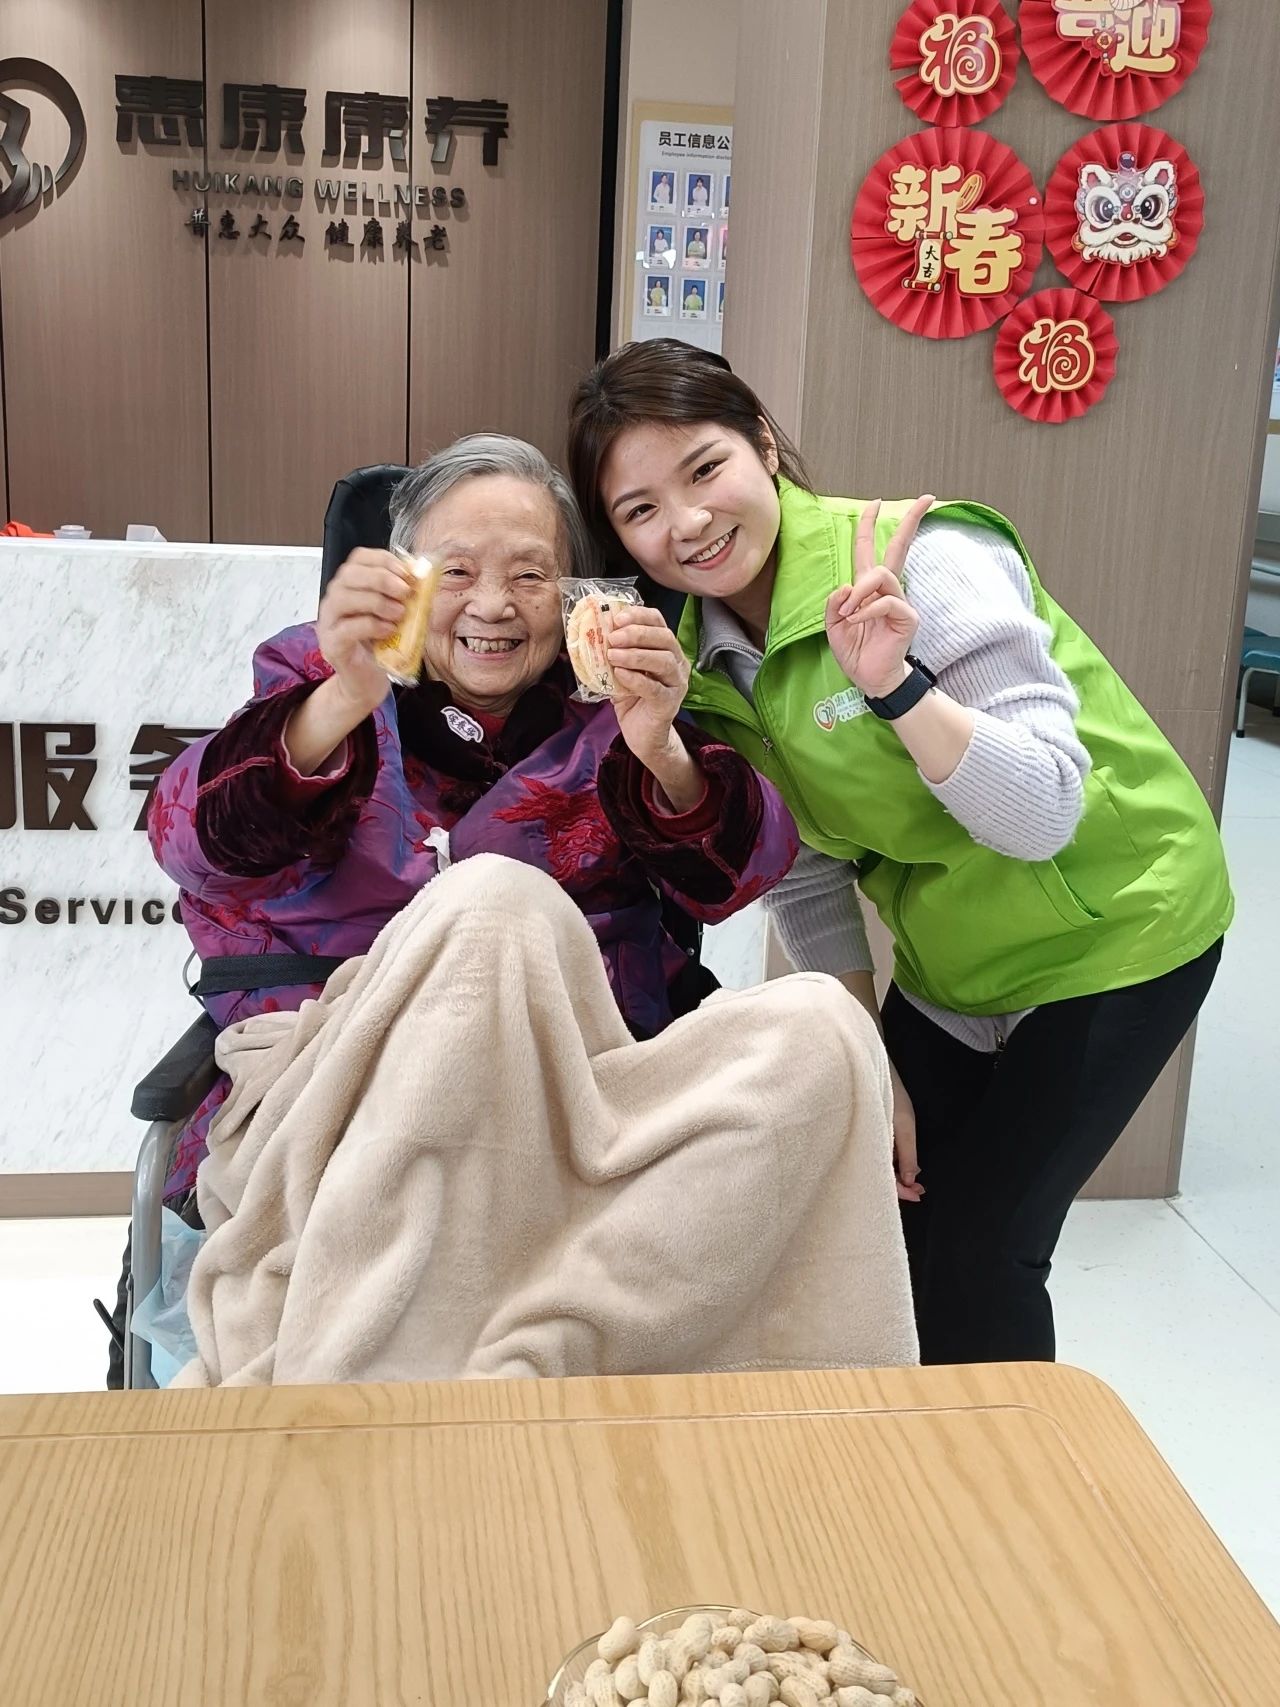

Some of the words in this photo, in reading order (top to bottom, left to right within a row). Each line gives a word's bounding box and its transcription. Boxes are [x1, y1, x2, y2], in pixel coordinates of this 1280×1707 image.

[920, 15, 1001, 95] 福
[172, 169, 304, 199] HUIKANG
[314, 179, 466, 209] WELLNESS
[887, 164, 1022, 294] 新春
[923, 245, 940, 278] 大吉
[1019, 318, 1095, 392] 福
